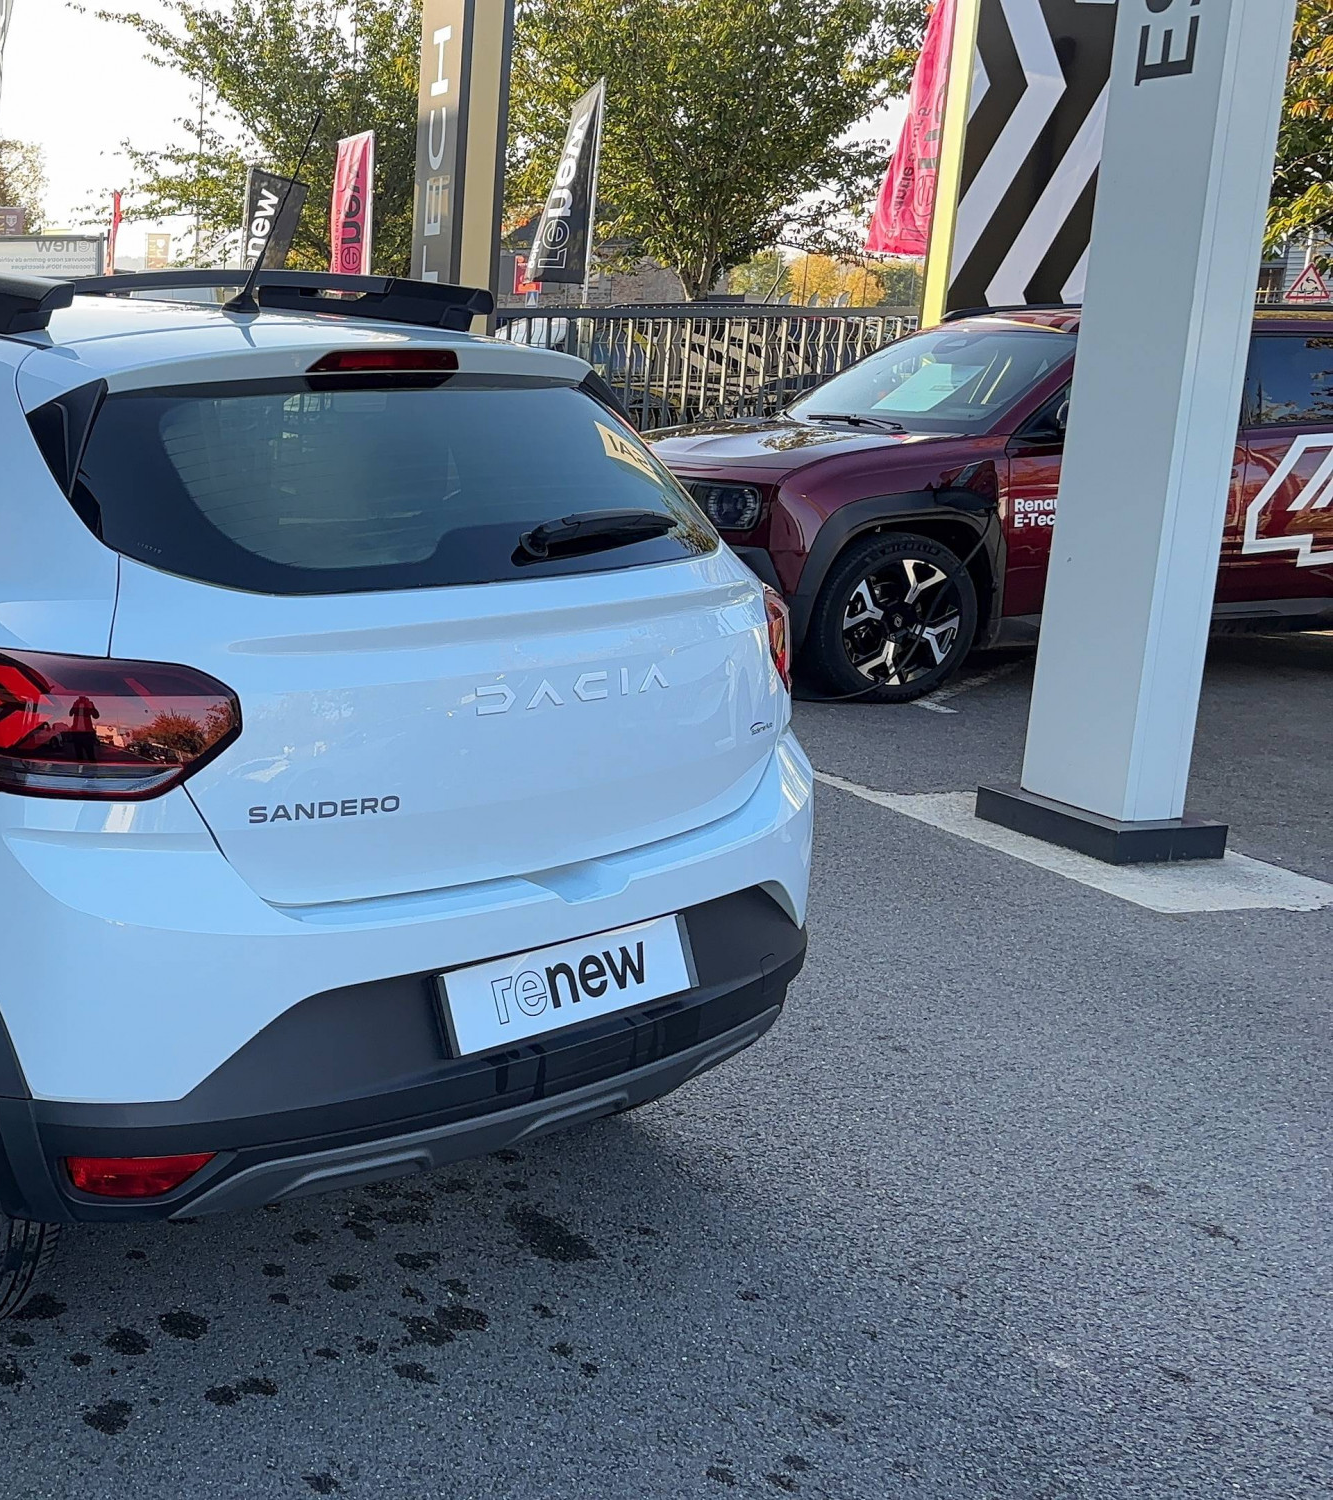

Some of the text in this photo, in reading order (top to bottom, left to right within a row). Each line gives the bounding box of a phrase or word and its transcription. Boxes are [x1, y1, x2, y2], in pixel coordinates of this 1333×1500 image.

[244, 188, 279, 270] enew
[1014, 498, 1057, 513] Rena
[1014, 513, 1056, 528] E-Tec
[476, 663, 670, 716] DACIA
[248, 795, 400, 824] SANDERO
[491, 941, 645, 1025] renew
